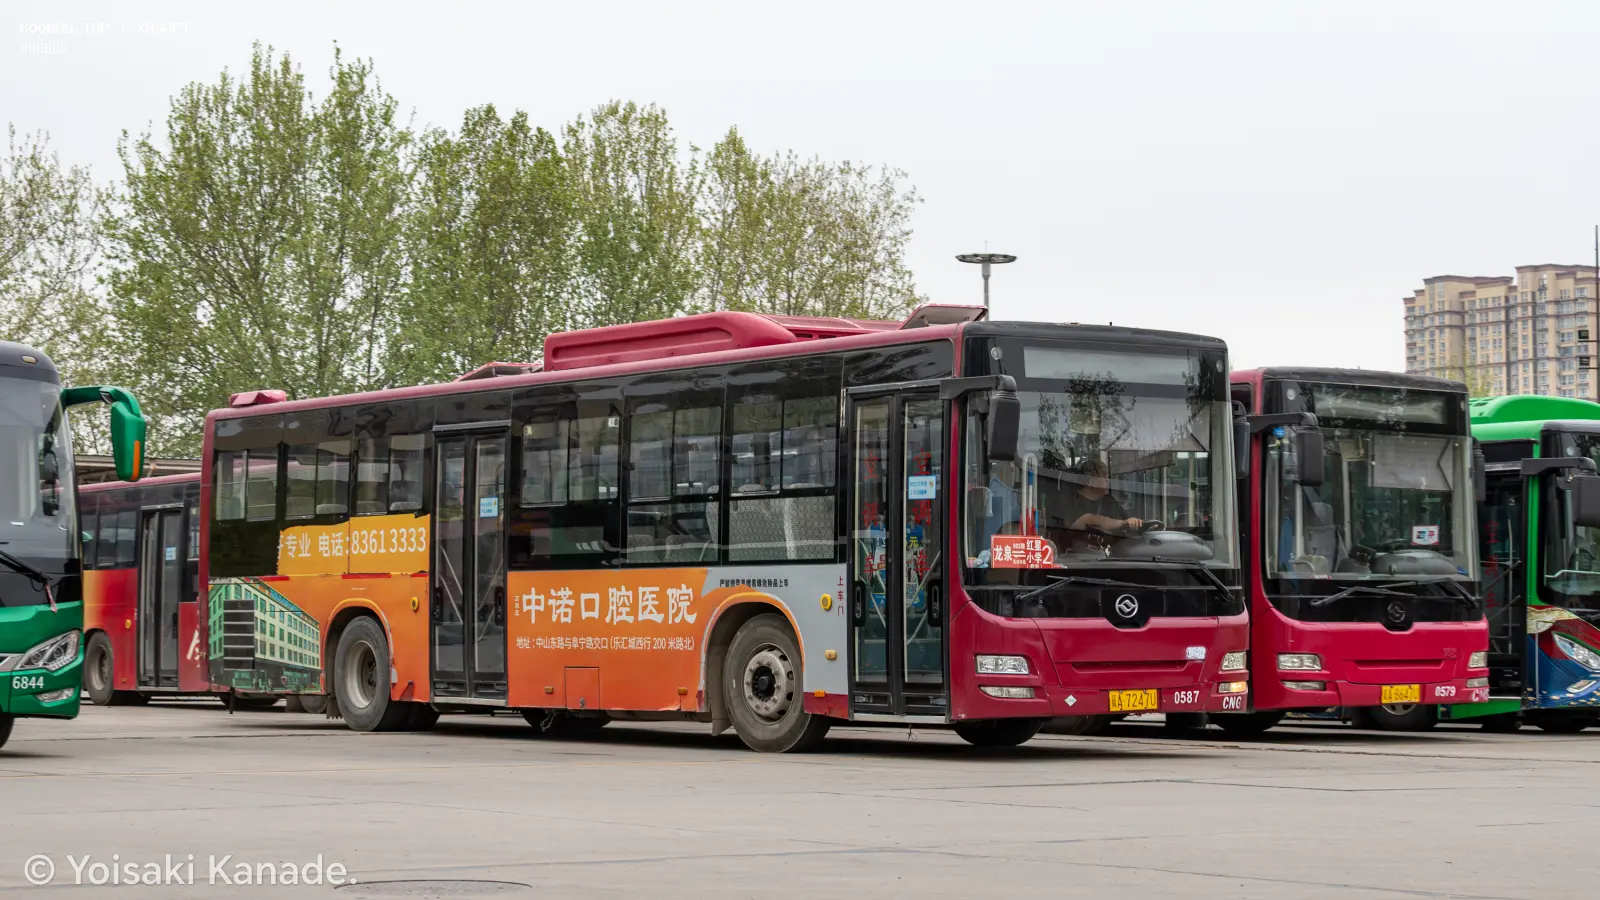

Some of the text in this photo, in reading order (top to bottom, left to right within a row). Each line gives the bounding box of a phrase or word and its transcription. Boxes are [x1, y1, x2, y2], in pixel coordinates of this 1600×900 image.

[1026, 539, 1042, 551] 红星
[994, 545, 1013, 561] 龙泉
[1026, 552, 1042, 563] 小学
[1042, 545, 1052, 564] 2
[522, 584, 697, 625] 中诺口腔医院
[12, 676, 44, 689] 6844
[1174, 690, 1200, 704] 0587
[1434, 686, 1456, 697] 0579
[1222, 696, 1242, 709] CNG
